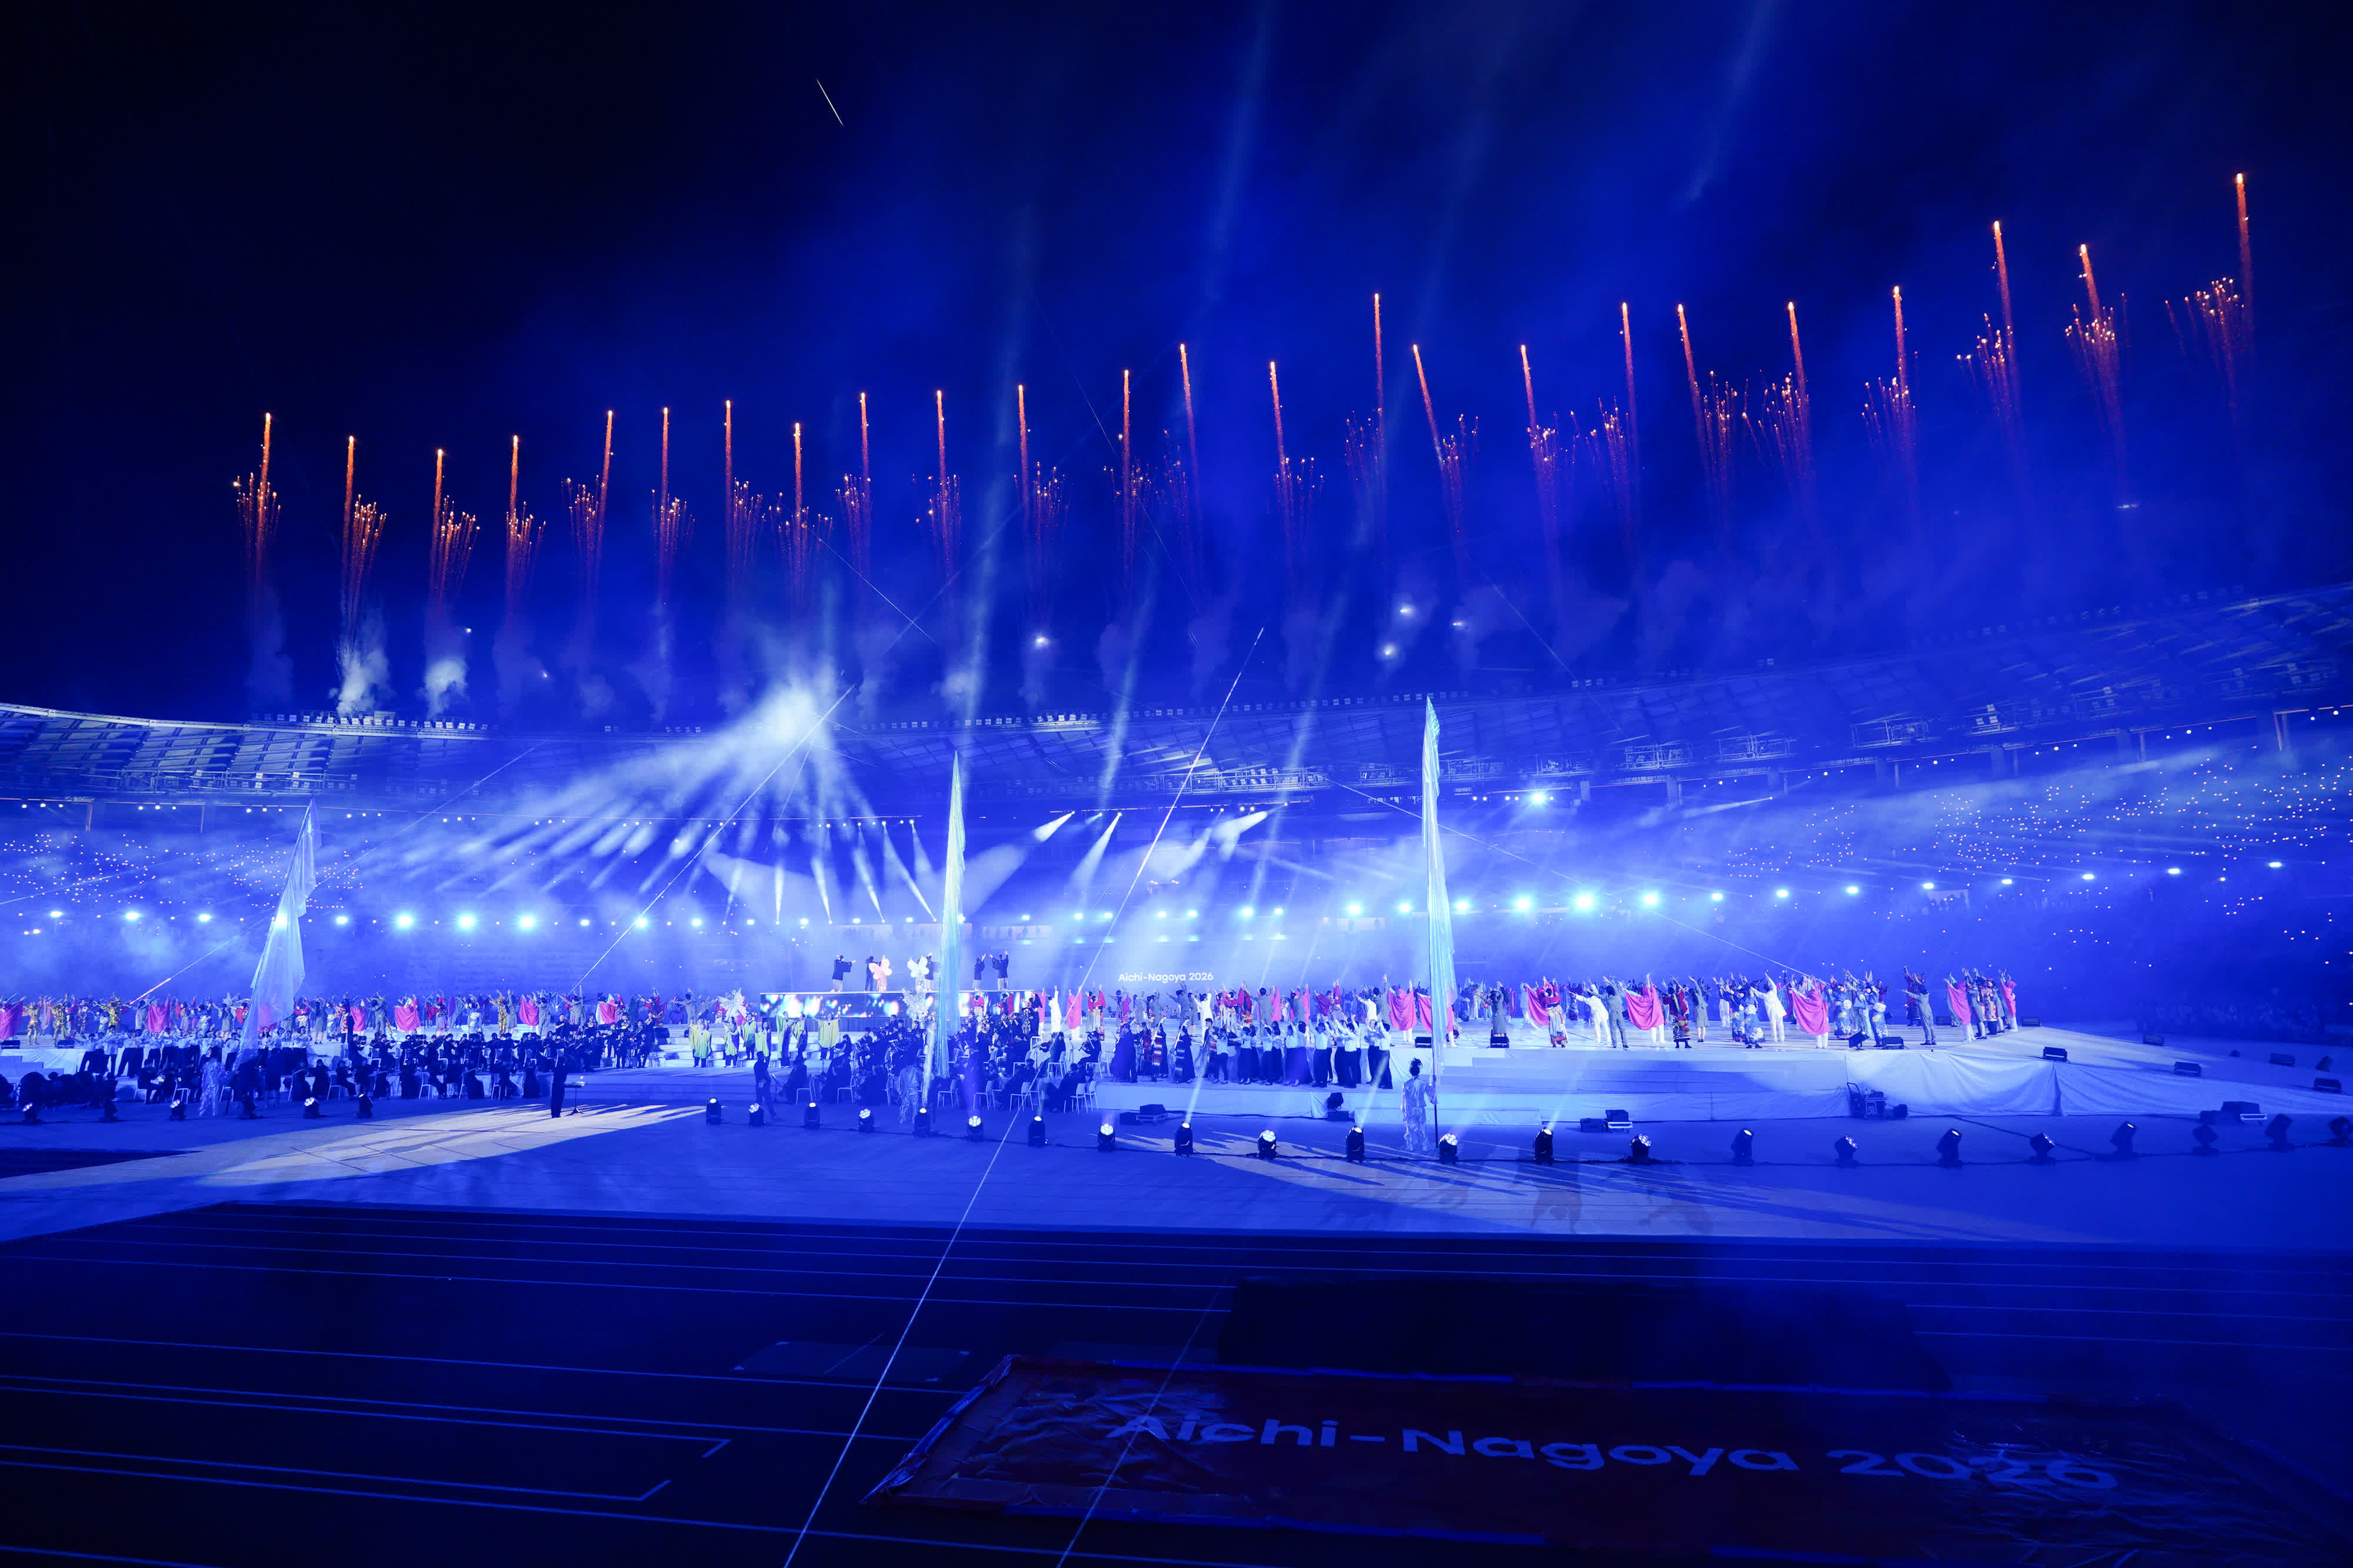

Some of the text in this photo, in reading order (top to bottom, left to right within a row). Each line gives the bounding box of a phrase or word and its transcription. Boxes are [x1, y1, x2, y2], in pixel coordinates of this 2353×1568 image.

[1118, 972, 1214, 983] Aichi-Nagoya 2026
[1106, 1414, 2119, 1490] Aichi-Nagoya 2026
